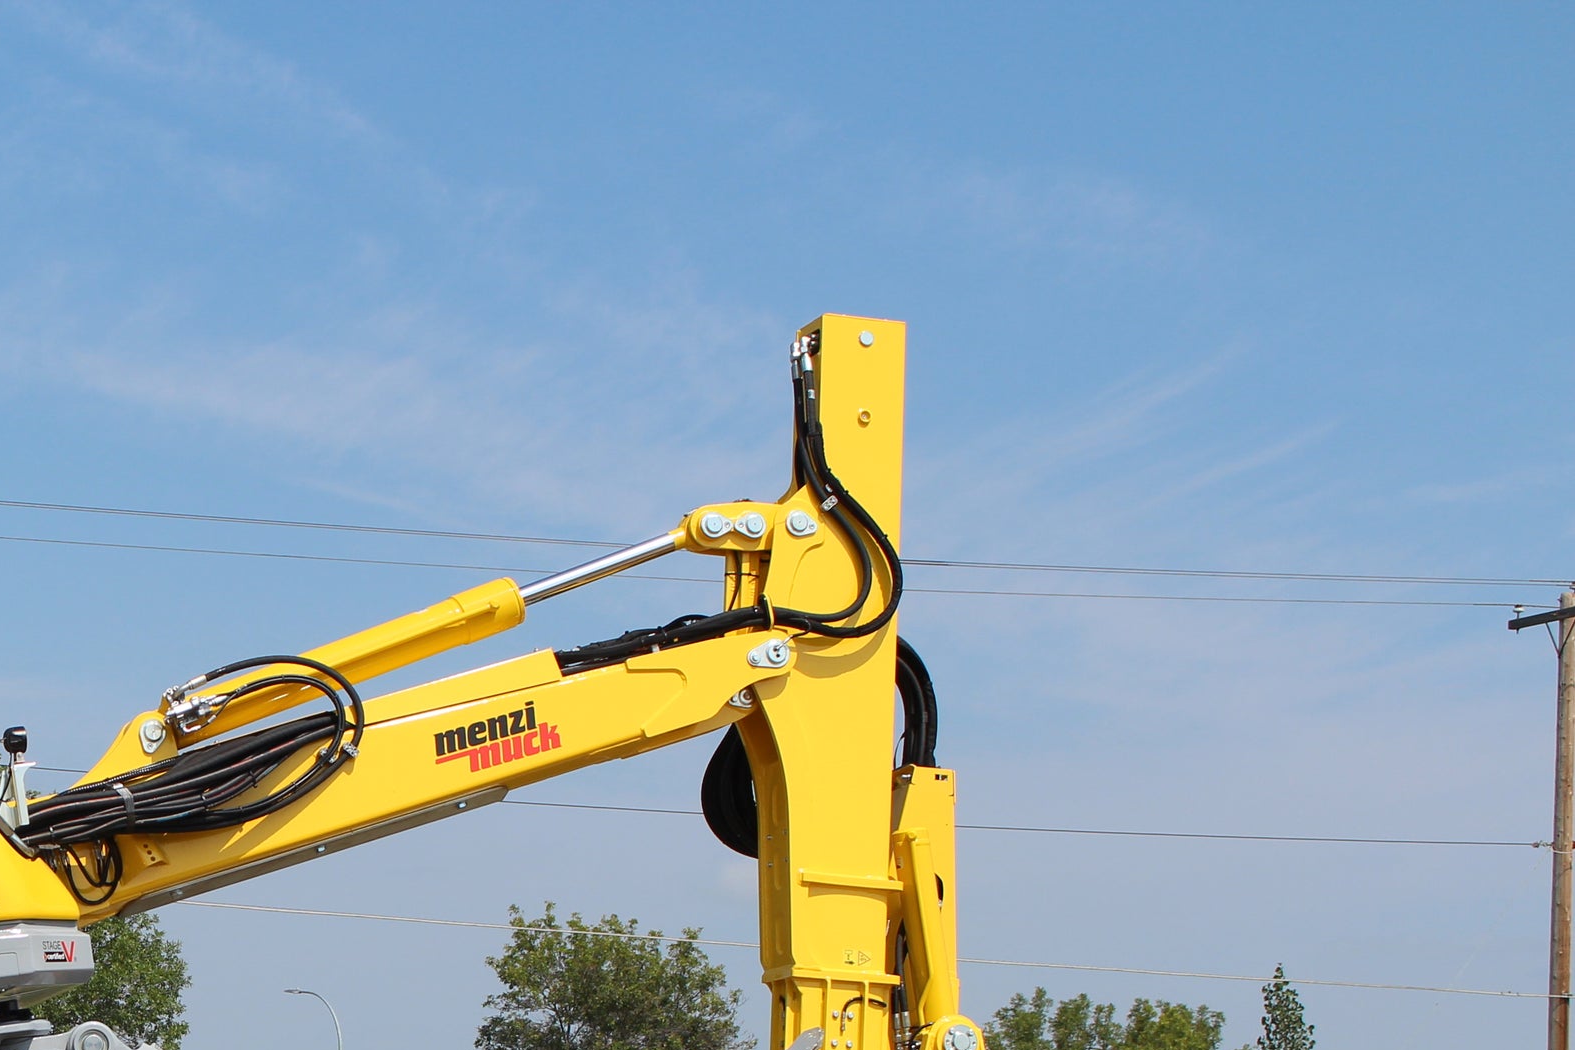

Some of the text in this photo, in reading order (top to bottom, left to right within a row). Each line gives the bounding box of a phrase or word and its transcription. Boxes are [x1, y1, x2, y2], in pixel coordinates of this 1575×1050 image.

[434, 701, 537, 757] menzi
[435, 722, 561, 773] muck
[42, 940, 75, 962] STAGE V
